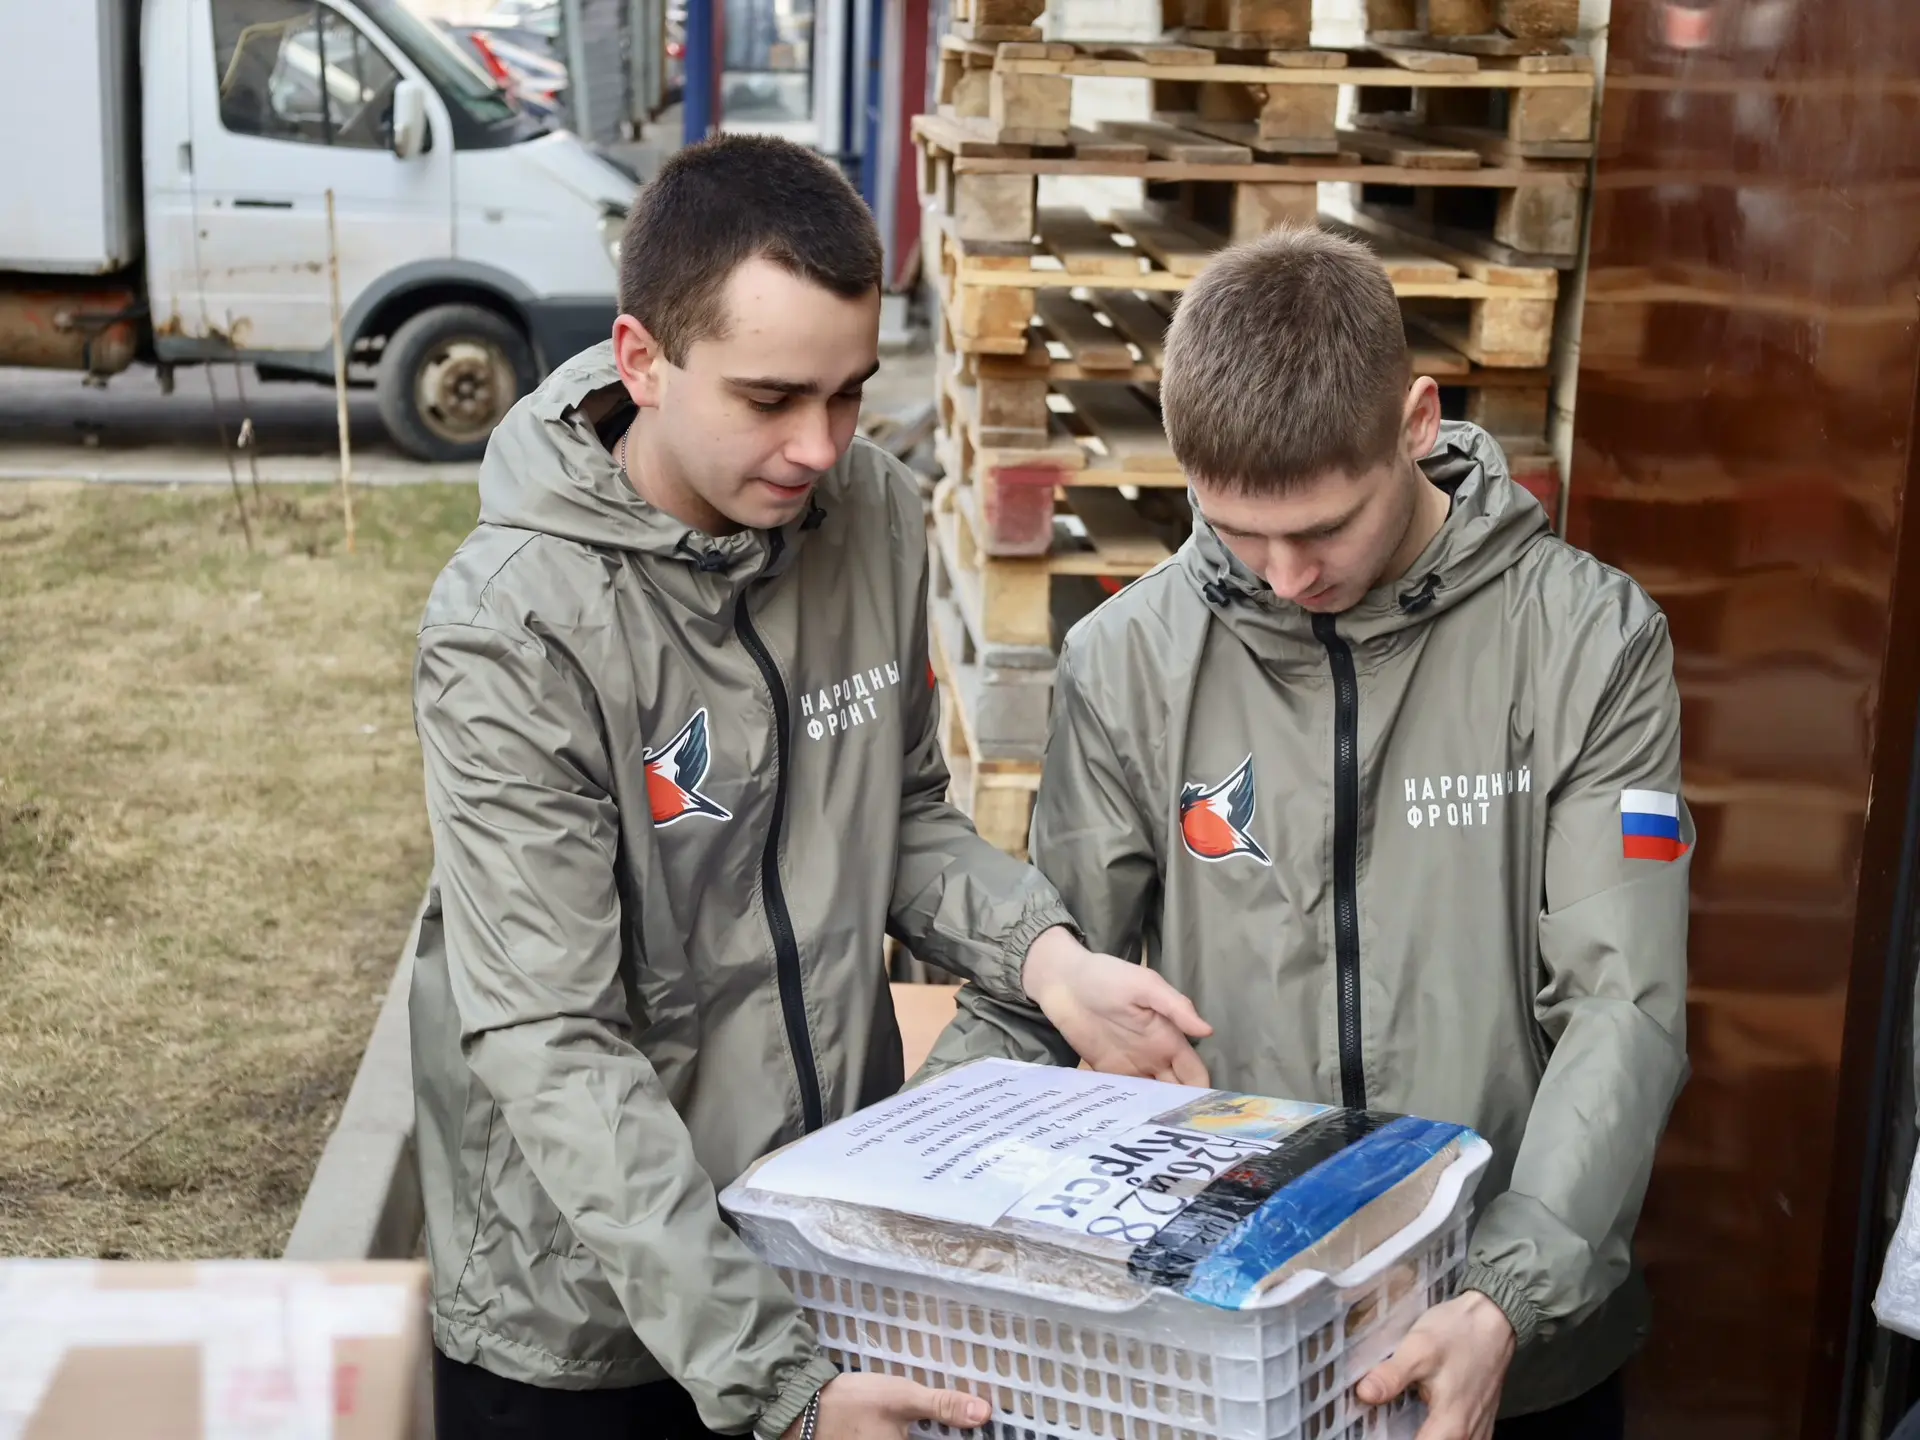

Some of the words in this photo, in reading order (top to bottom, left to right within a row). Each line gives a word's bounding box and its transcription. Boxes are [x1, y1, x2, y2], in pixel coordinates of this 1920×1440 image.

[800, 660, 900, 717] НАРОДНЫ
[806, 697, 878, 741] ФРОНТ
[1406, 802, 1490, 829] ФРОНТ
